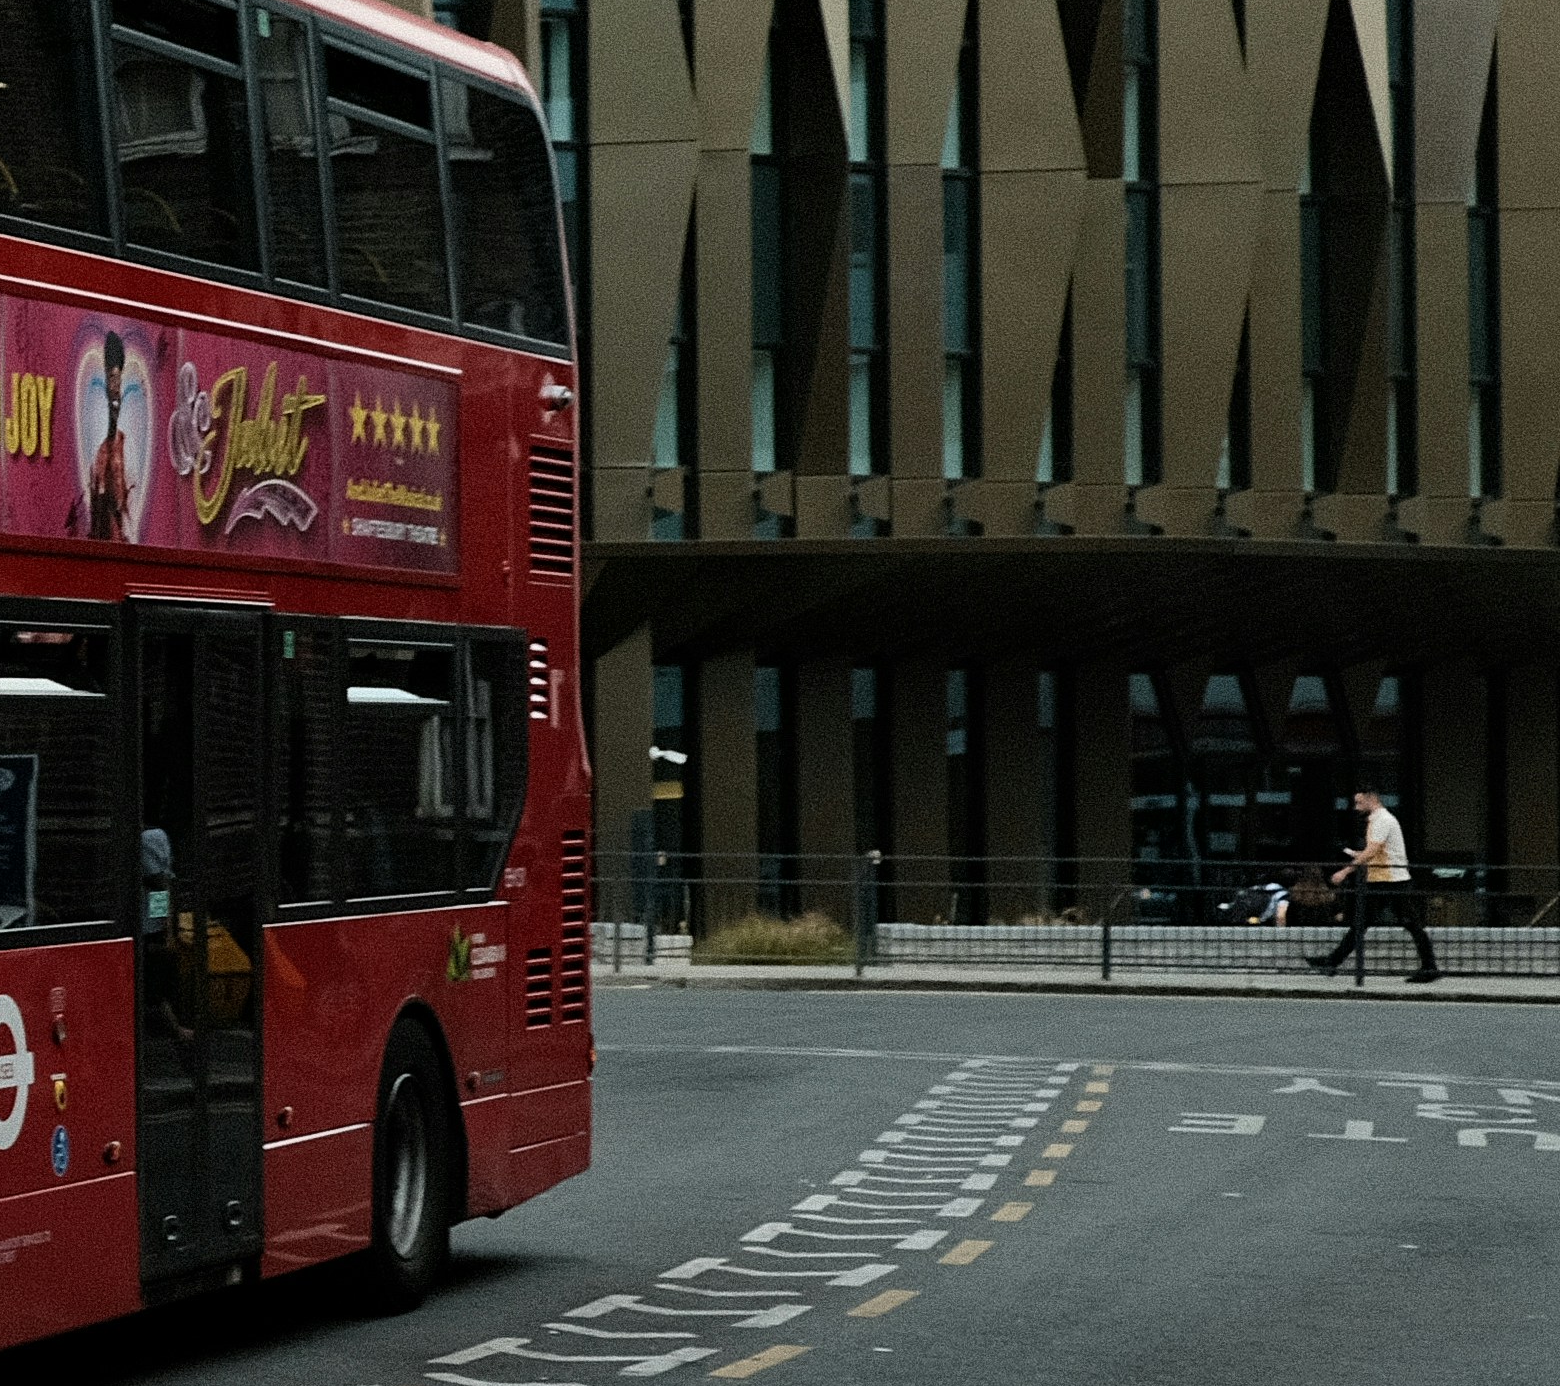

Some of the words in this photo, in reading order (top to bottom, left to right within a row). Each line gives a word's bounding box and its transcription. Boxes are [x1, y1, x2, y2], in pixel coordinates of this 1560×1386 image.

[5, 372, 56, 458] JOY
[1273, 1077, 1560, 1106] NLY
[1167, 1113, 1560, 1152] UTE
